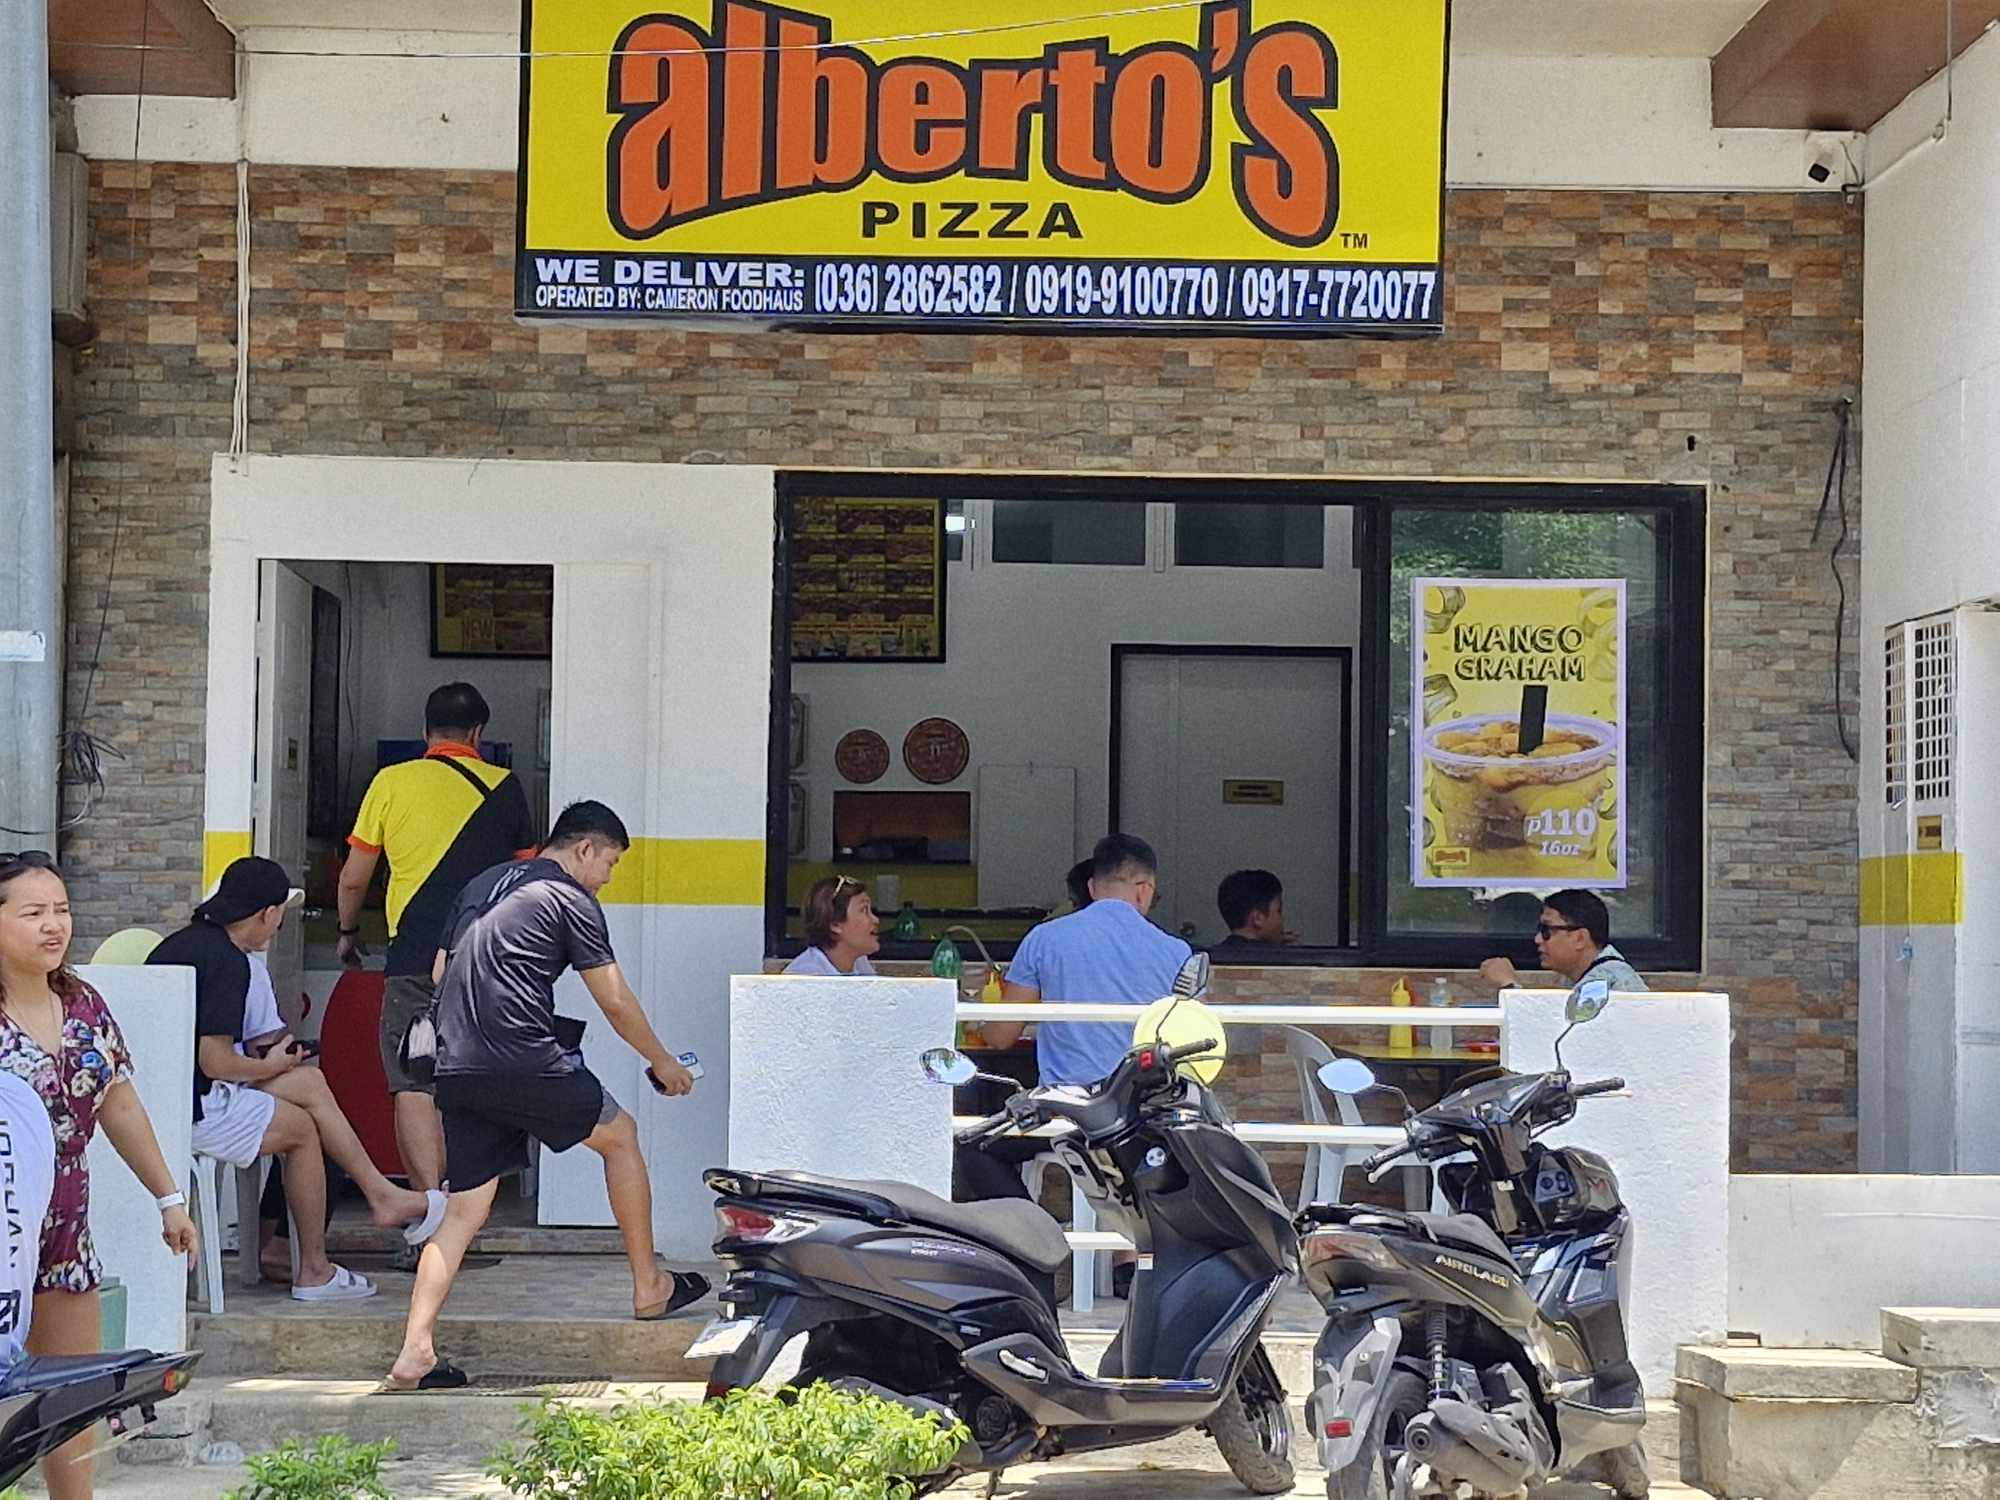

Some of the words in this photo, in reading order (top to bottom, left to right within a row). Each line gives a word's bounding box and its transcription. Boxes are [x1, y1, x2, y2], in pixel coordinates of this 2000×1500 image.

[862, 201, 1084, 239] PIZZA
[1340, 232, 1368, 249] TM
[534, 257, 600, 284] WE
[613, 259, 805, 288] DELIVER:
[535, 284, 615, 309] OPERATED
[618, 287, 641, 310] BY:
[645, 287, 719, 312] CAMERON
[722, 288, 804, 312] FOODHAUS
[815, 263, 879, 313] (036)
[884, 264, 1002, 314] 2862582
[1009, 264, 1019, 315] /
[1025, 264, 1219, 317] 0919-9100770
[1225, 267, 1236, 318] /
[1242, 266, 1437, 320] 0917-7720077
[1454, 622, 1585, 654] MANGO
[1455, 655, 1586, 682] GRAHAM
